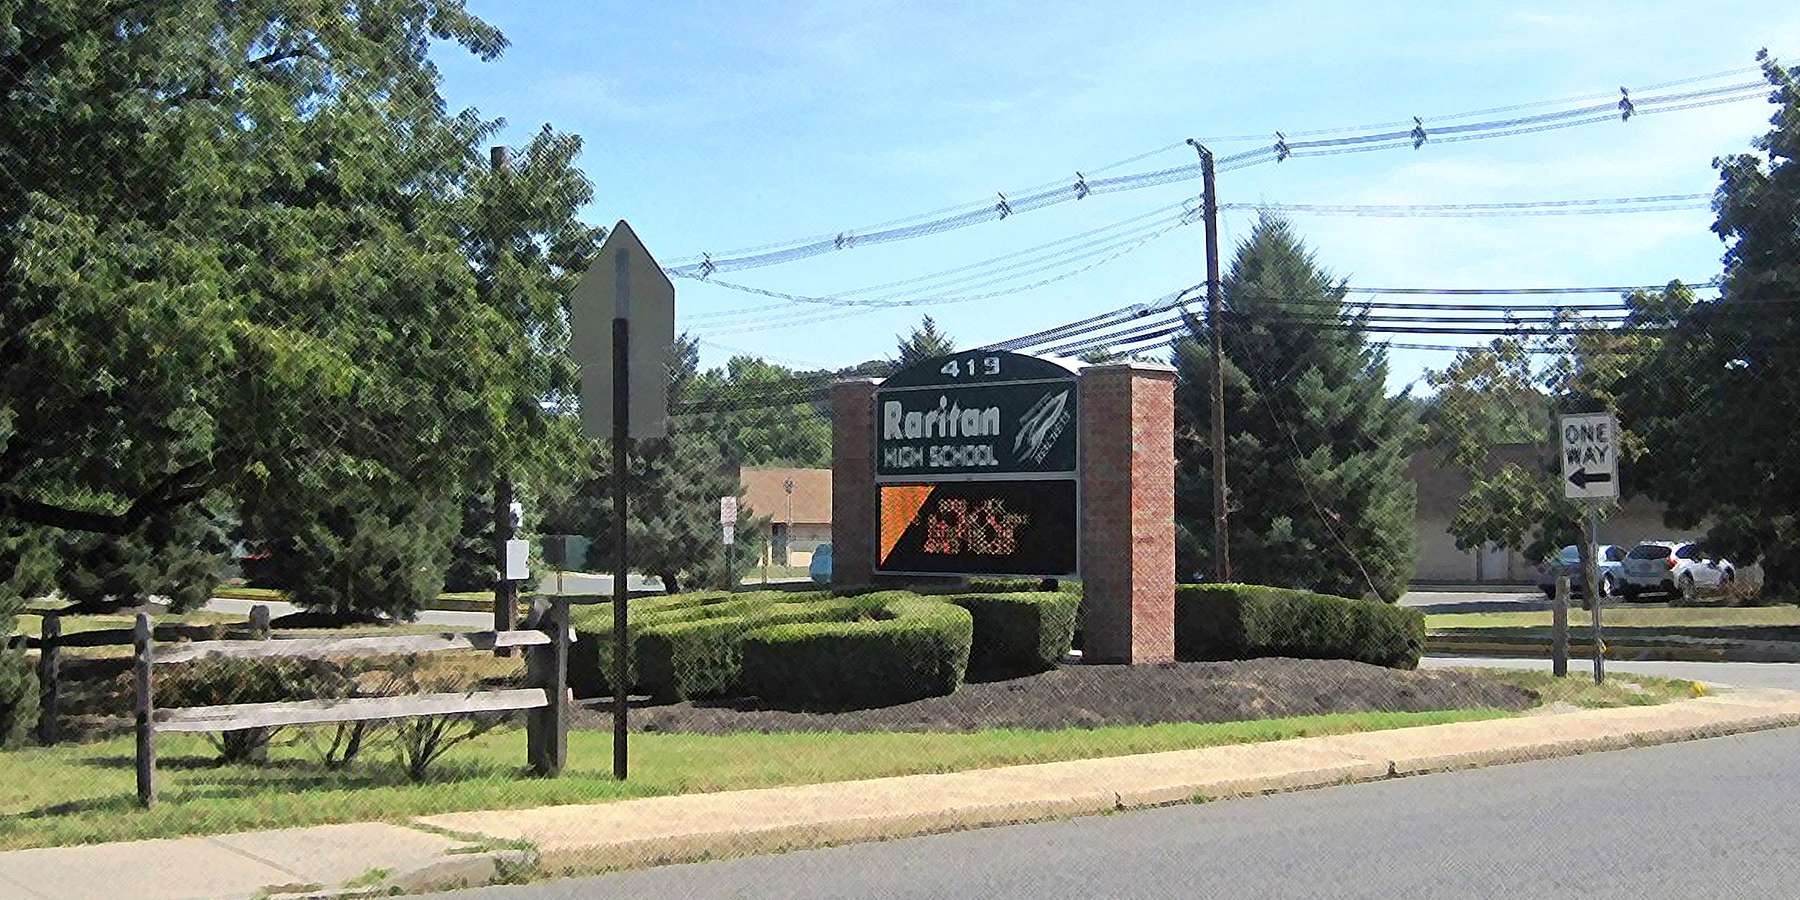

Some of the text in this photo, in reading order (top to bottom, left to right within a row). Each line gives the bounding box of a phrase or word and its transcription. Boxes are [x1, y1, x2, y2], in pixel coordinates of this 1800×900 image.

[941, 356, 1000, 377] 419
[884, 395, 1000, 440] Raritan
[1565, 423, 1608, 444] ONE
[884, 444, 999, 468] HIGH SCHOOL
[1566, 445, 1609, 464] WAY
